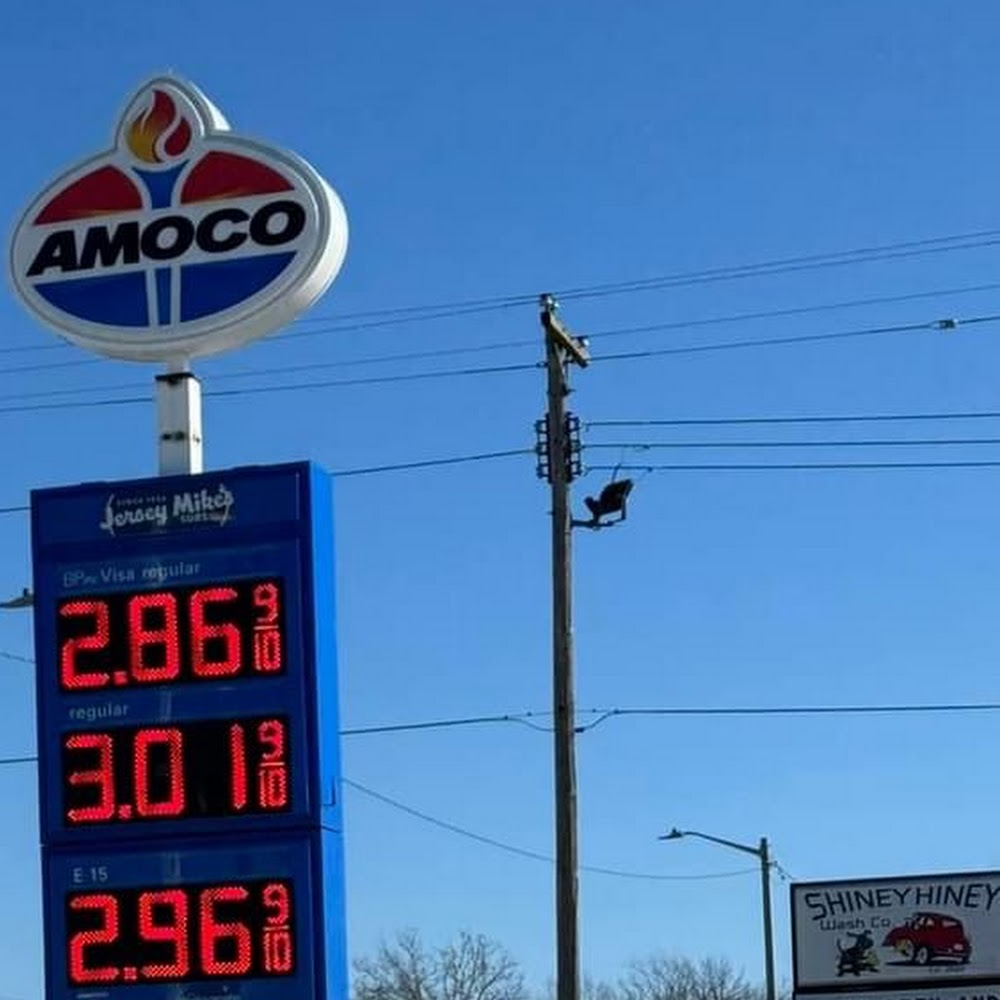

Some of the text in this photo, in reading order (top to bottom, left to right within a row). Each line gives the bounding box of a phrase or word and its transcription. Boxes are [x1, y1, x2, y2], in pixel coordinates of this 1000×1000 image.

[26, 200, 306, 277] AMOCO
[100, 494, 167, 537] Jersey
[101, 567, 135, 583] Visa
[142, 561, 200, 583] regular
[60, 588, 241, 687] 2.86
[70, 703, 129, 719] regular
[66, 724, 246, 821] 3.01
[70, 886, 251, 983] 2.96
[820, 917, 865, 931] Wash
